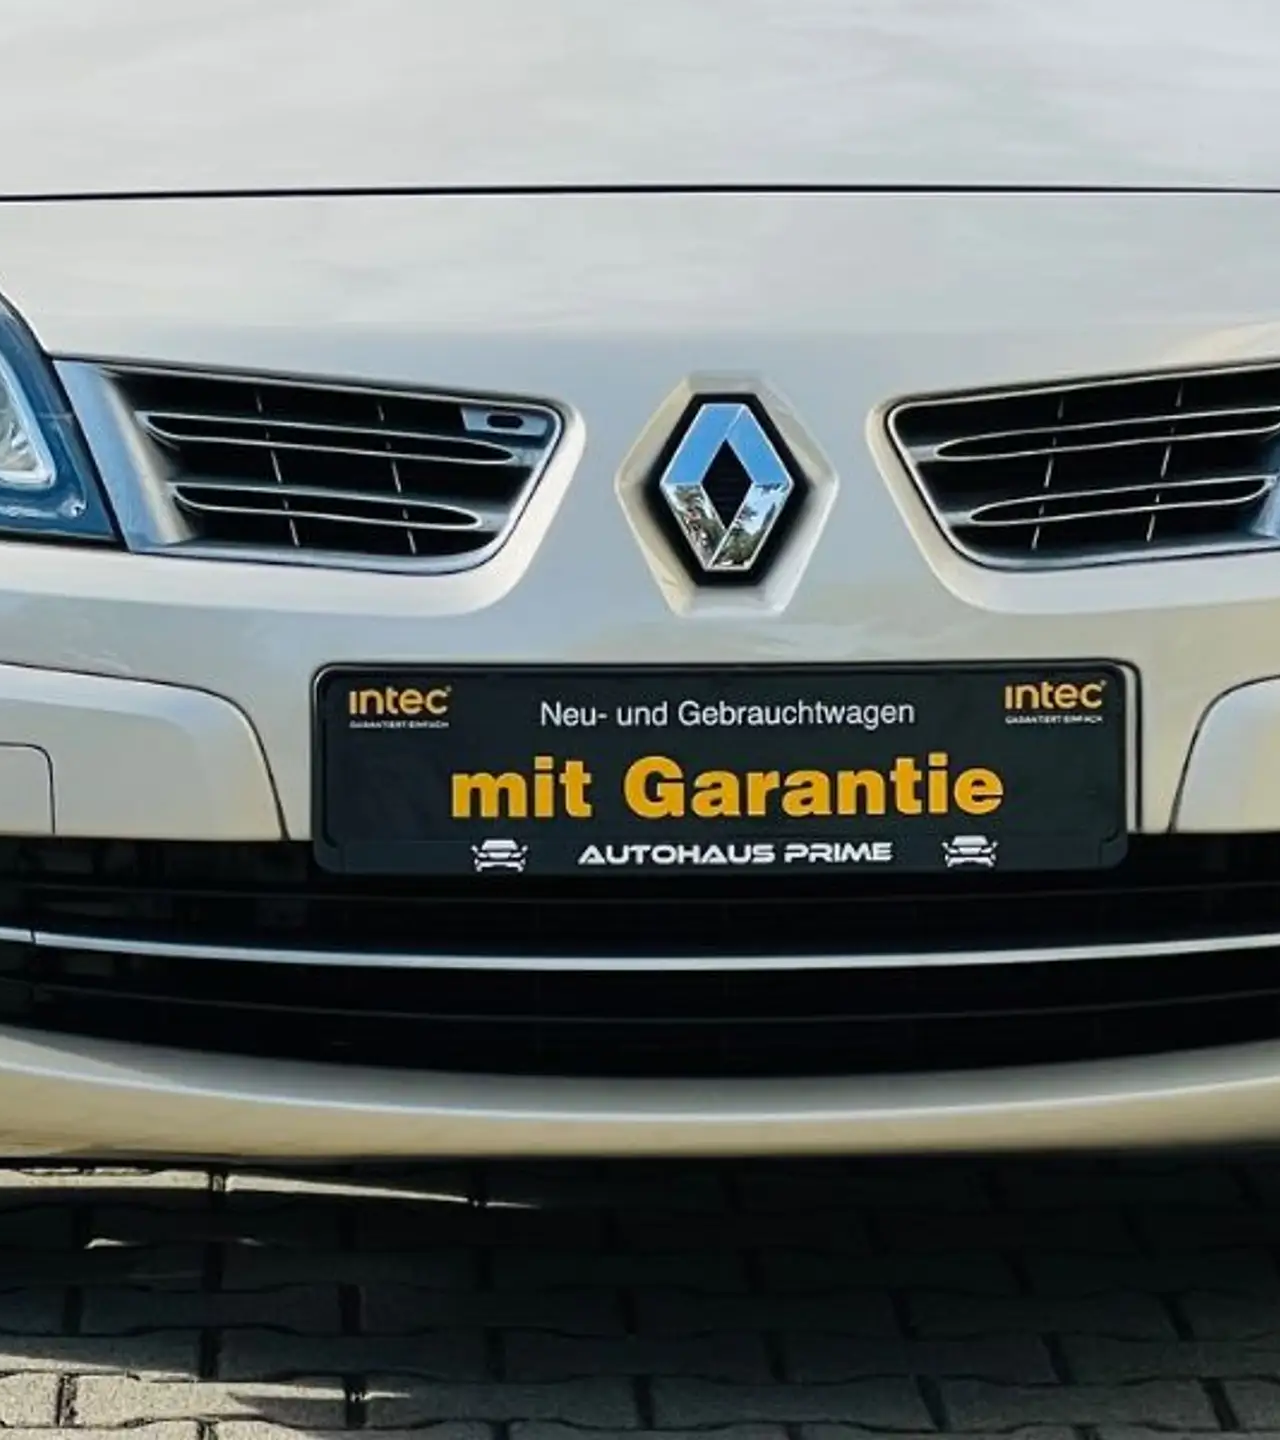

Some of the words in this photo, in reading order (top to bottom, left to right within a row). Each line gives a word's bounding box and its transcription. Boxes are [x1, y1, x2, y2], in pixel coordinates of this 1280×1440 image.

[349, 687, 452, 715] intec
[1004, 680, 1107, 710] intec
[541, 701, 607, 727] Neu-
[617, 701, 668, 726] und
[678, 699, 915, 731] Gebrauchtwagen
[451, 755, 592, 818] mit
[624, 752, 1005, 818] Garantie
[577, 844, 776, 865] AUTOHAUS
[783, 842, 894, 863] PRIME
